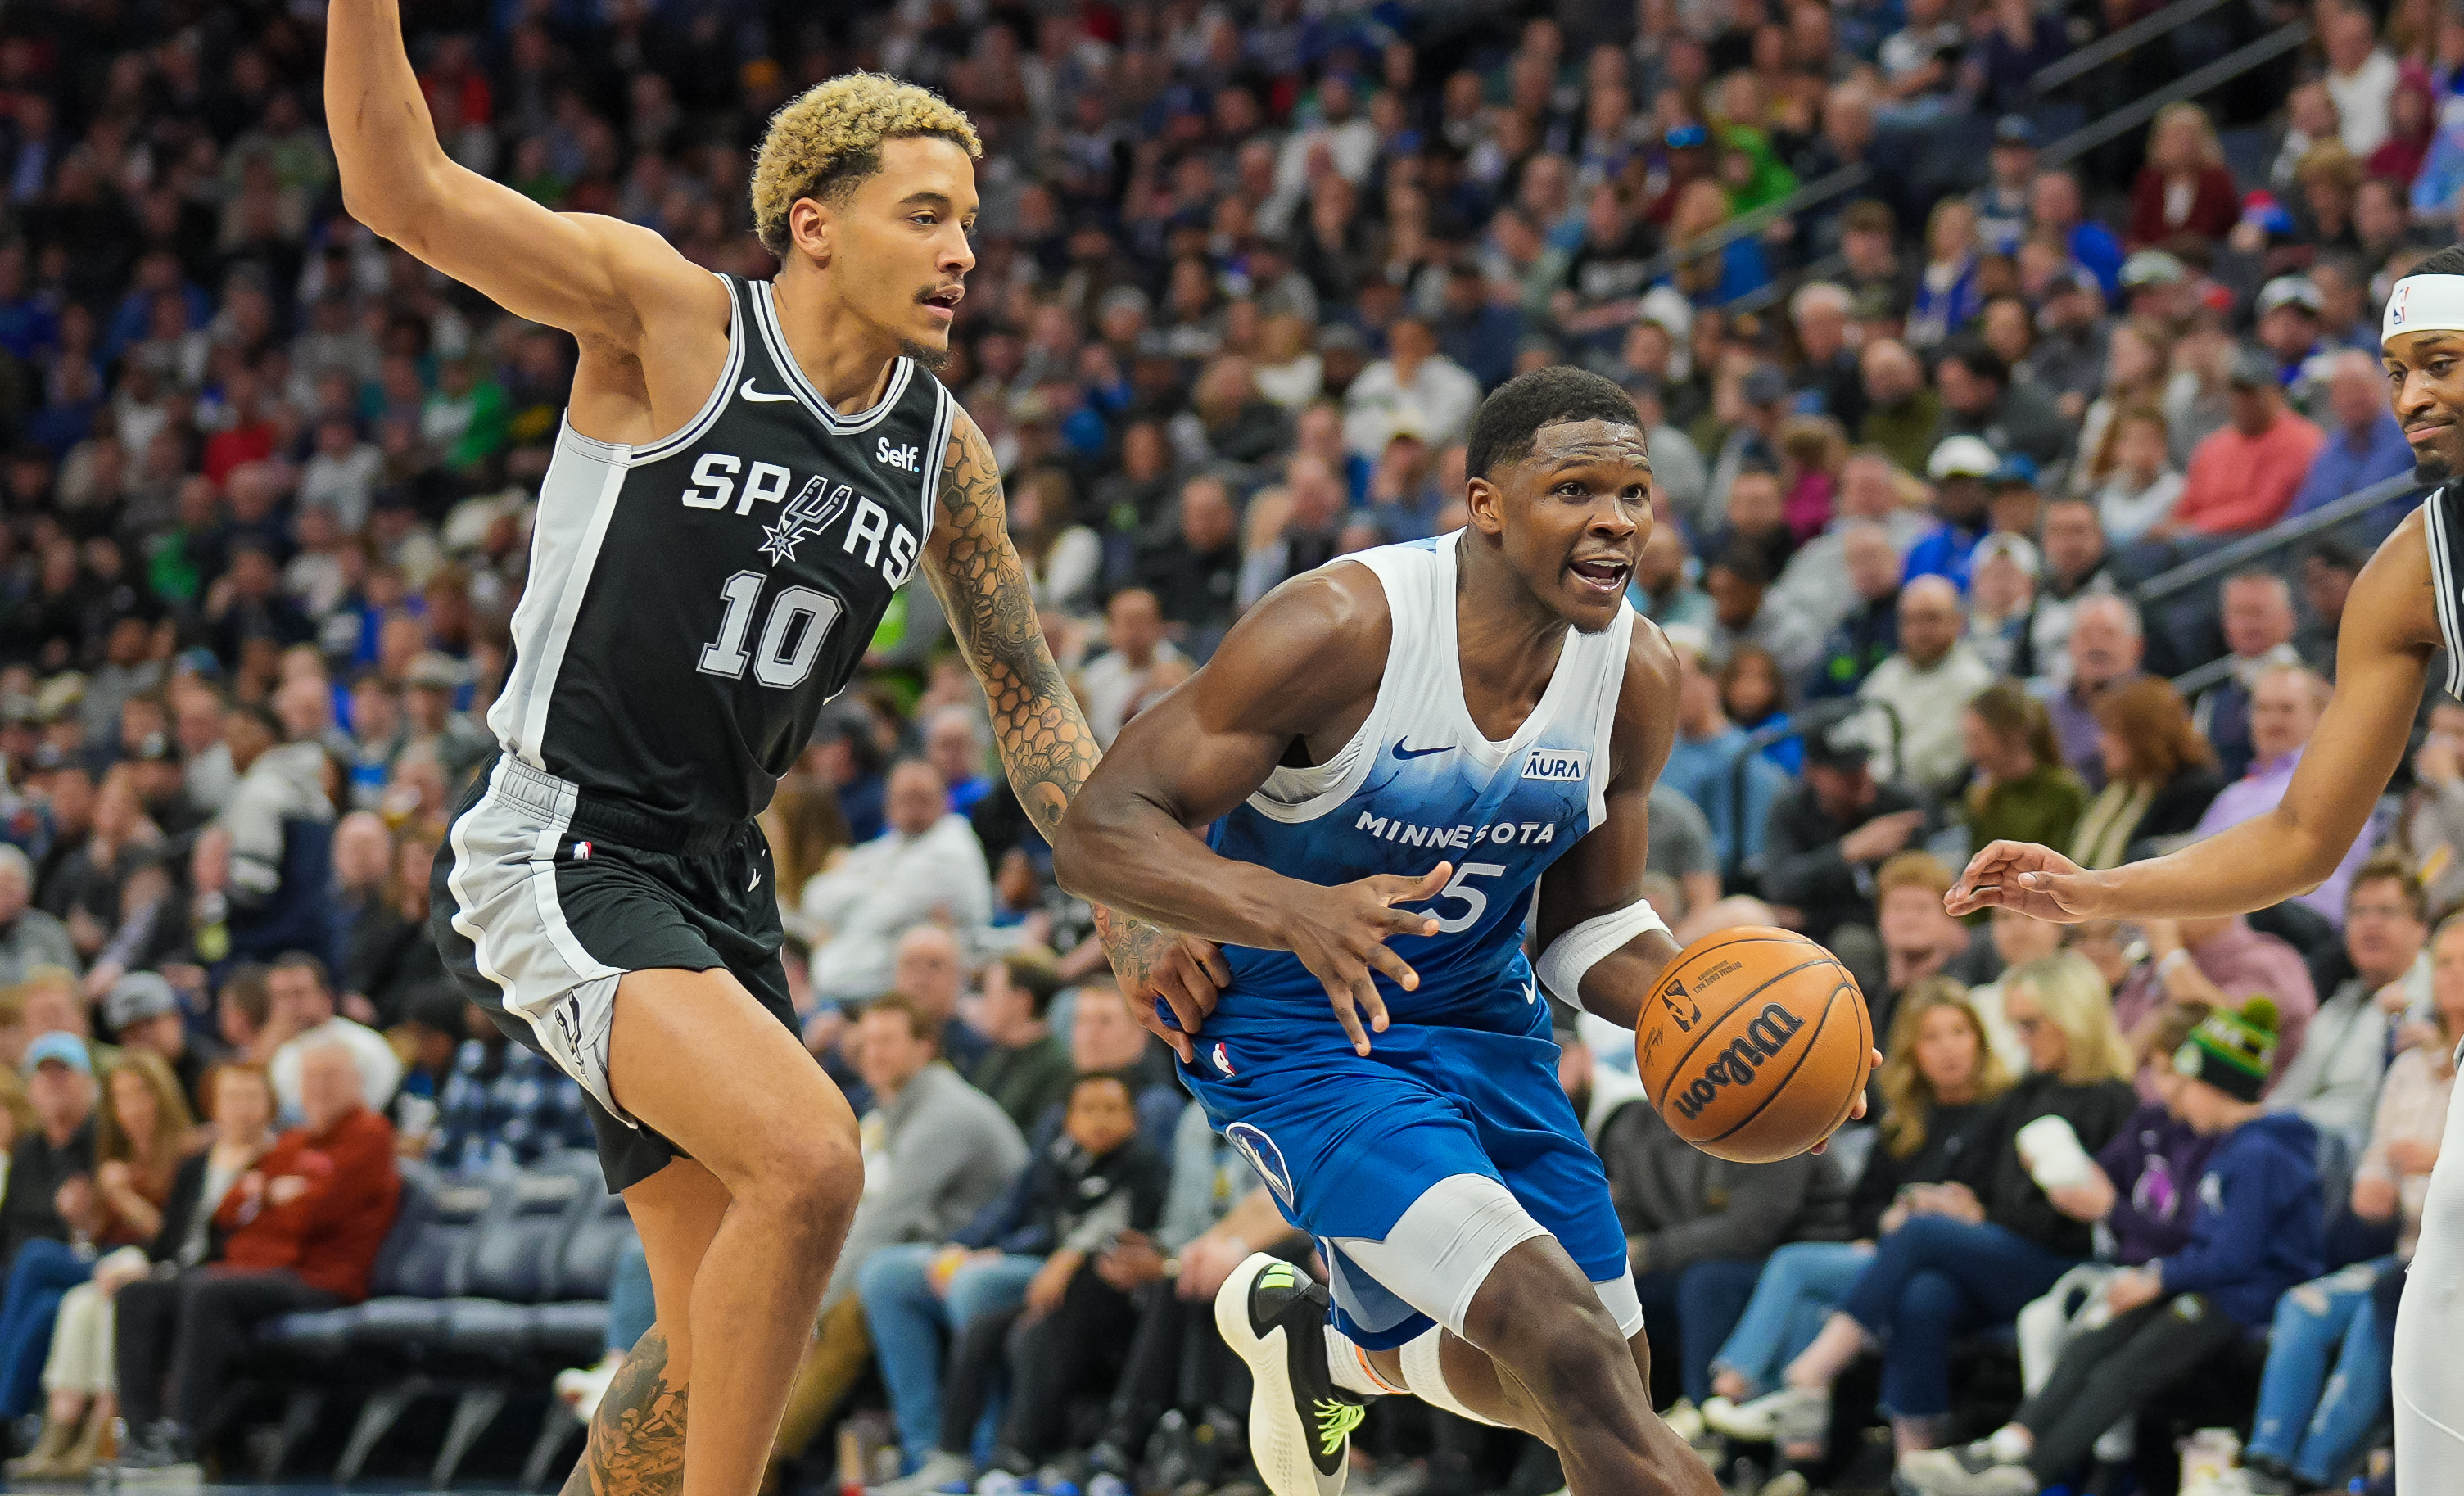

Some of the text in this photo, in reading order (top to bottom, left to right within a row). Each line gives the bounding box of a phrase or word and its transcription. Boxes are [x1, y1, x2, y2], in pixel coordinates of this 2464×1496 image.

[696, 569, 843, 689] 10
[1355, 811, 1555, 849] MINNESOTA
[1419, 862, 1508, 933] 5
[1673, 1001, 1806, 1120] Wilson
